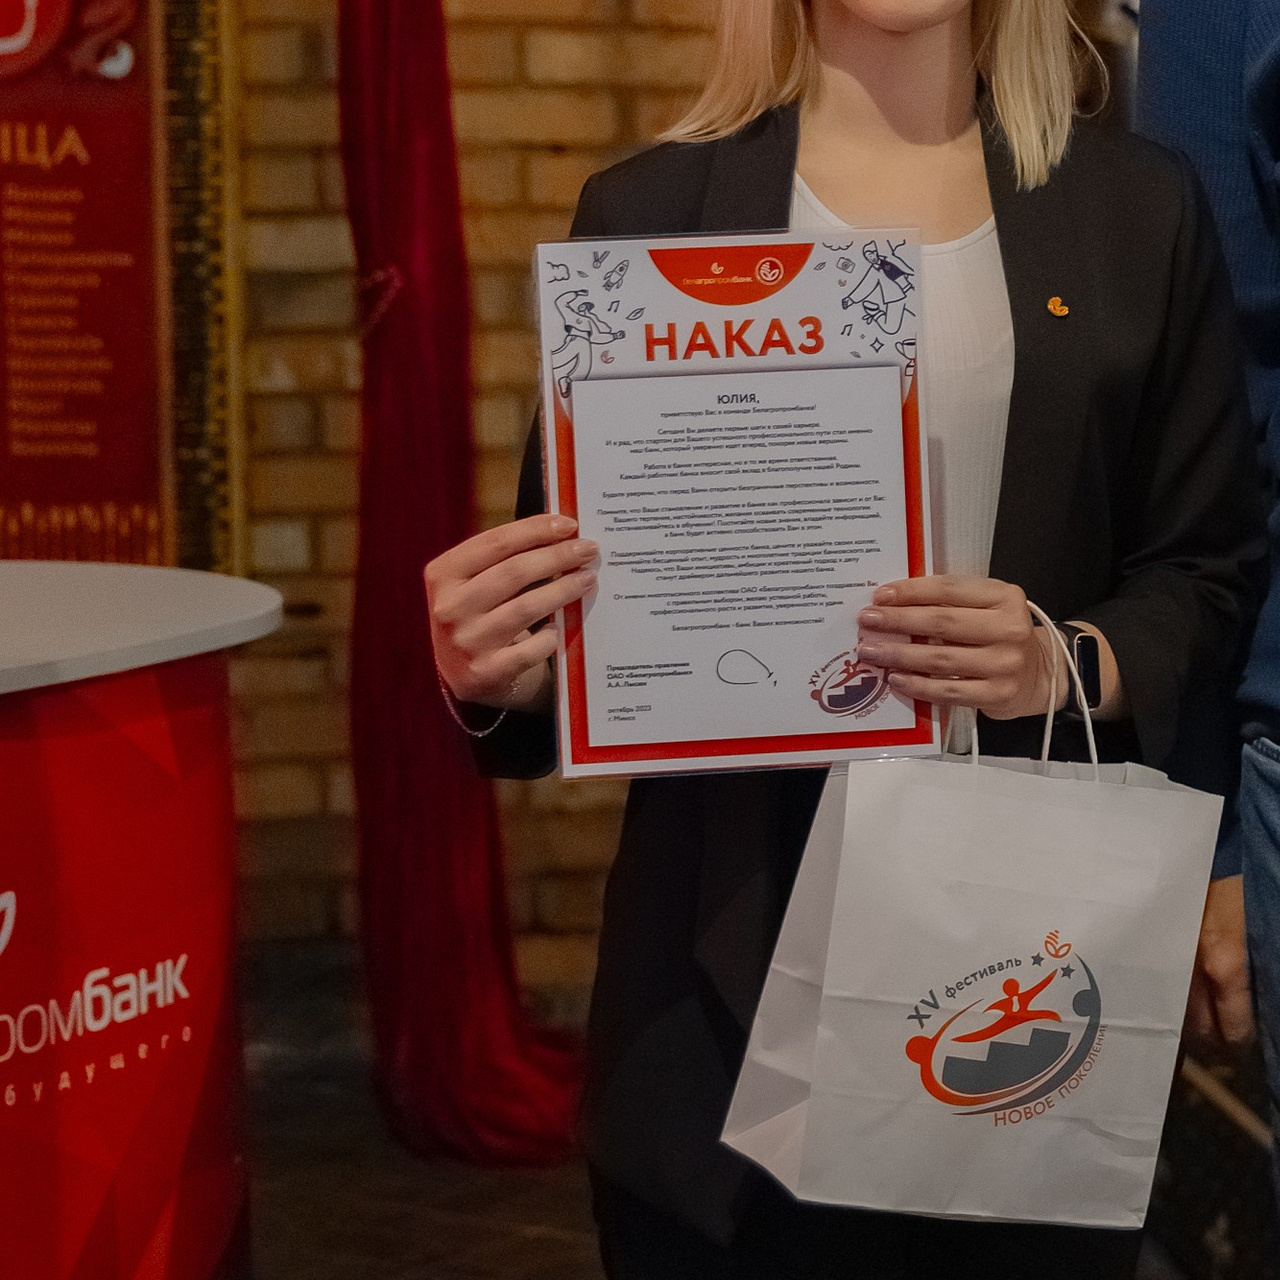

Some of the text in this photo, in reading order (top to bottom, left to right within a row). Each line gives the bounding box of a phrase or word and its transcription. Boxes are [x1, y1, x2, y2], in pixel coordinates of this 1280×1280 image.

[645, 316, 825, 362] НАКАЗ
[715, 392, 761, 406] ЮЛИЯ,
[634, 704, 652, 712] 2023
[907, 957, 1022, 1029] XV фестиваль
[993, 1023, 1108, 1127] НОВОЕ ПОКОЛЕНИЕ
